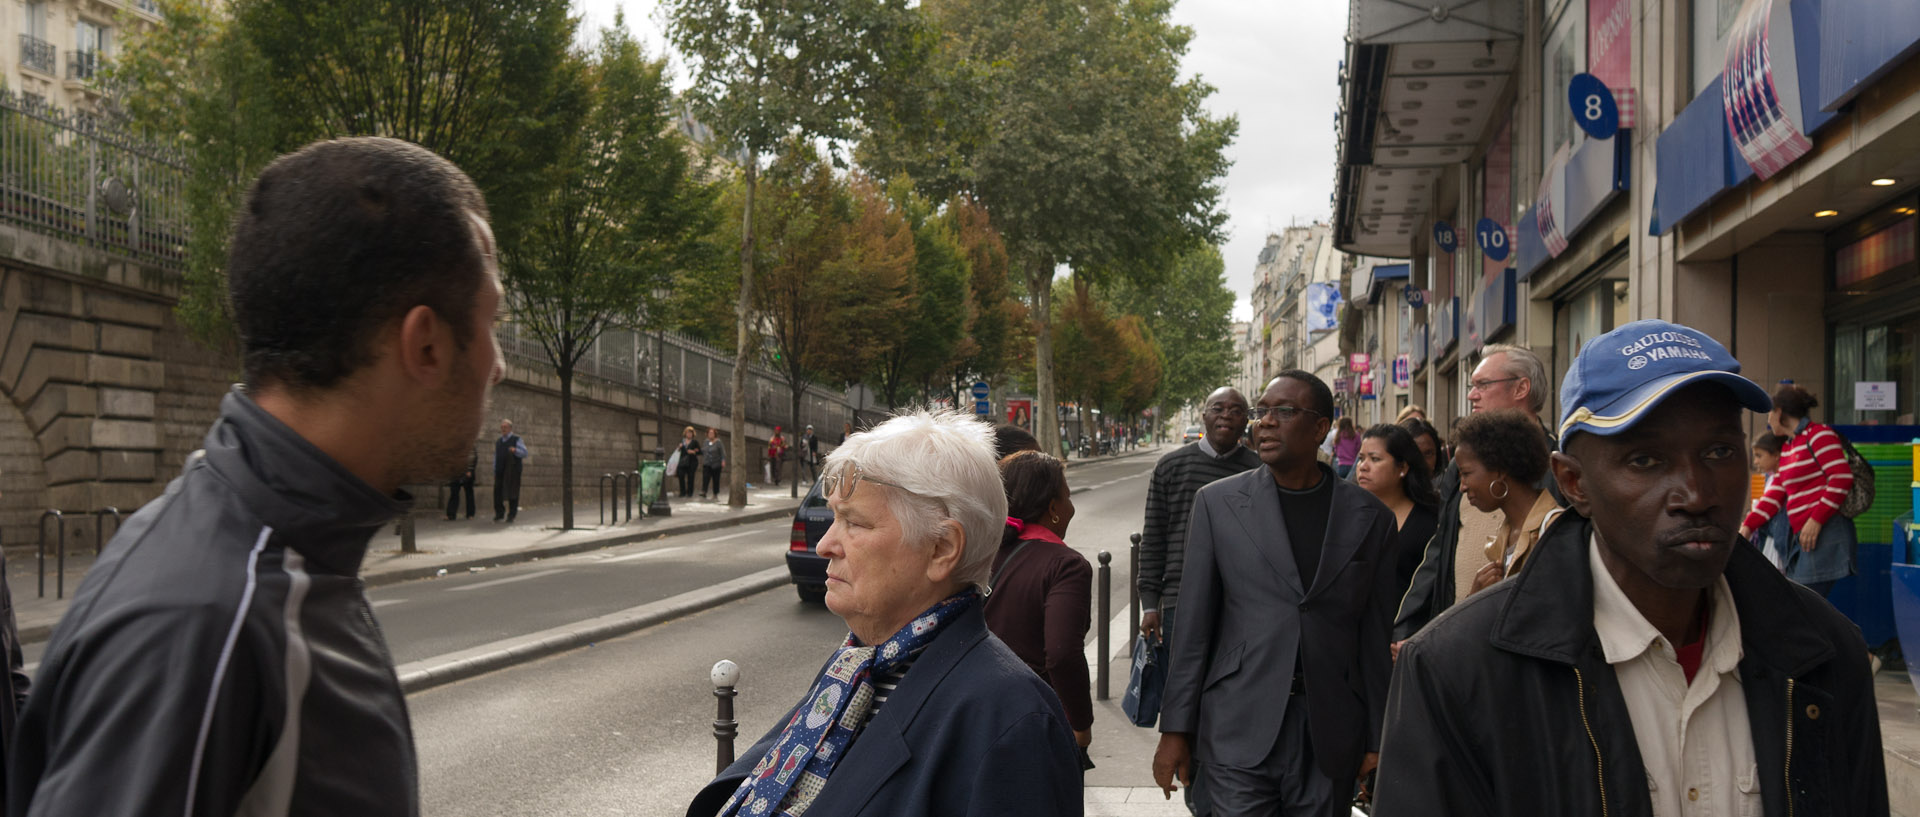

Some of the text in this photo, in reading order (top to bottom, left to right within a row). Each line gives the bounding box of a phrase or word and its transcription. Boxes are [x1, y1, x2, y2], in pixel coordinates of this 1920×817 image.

[1585, 94, 1602, 120] 8
[1438, 230, 1453, 244] 18
[1480, 230, 1504, 248] 10
[1407, 291, 1421, 302] 20
[1646, 346, 1713, 362] YAMAHA
